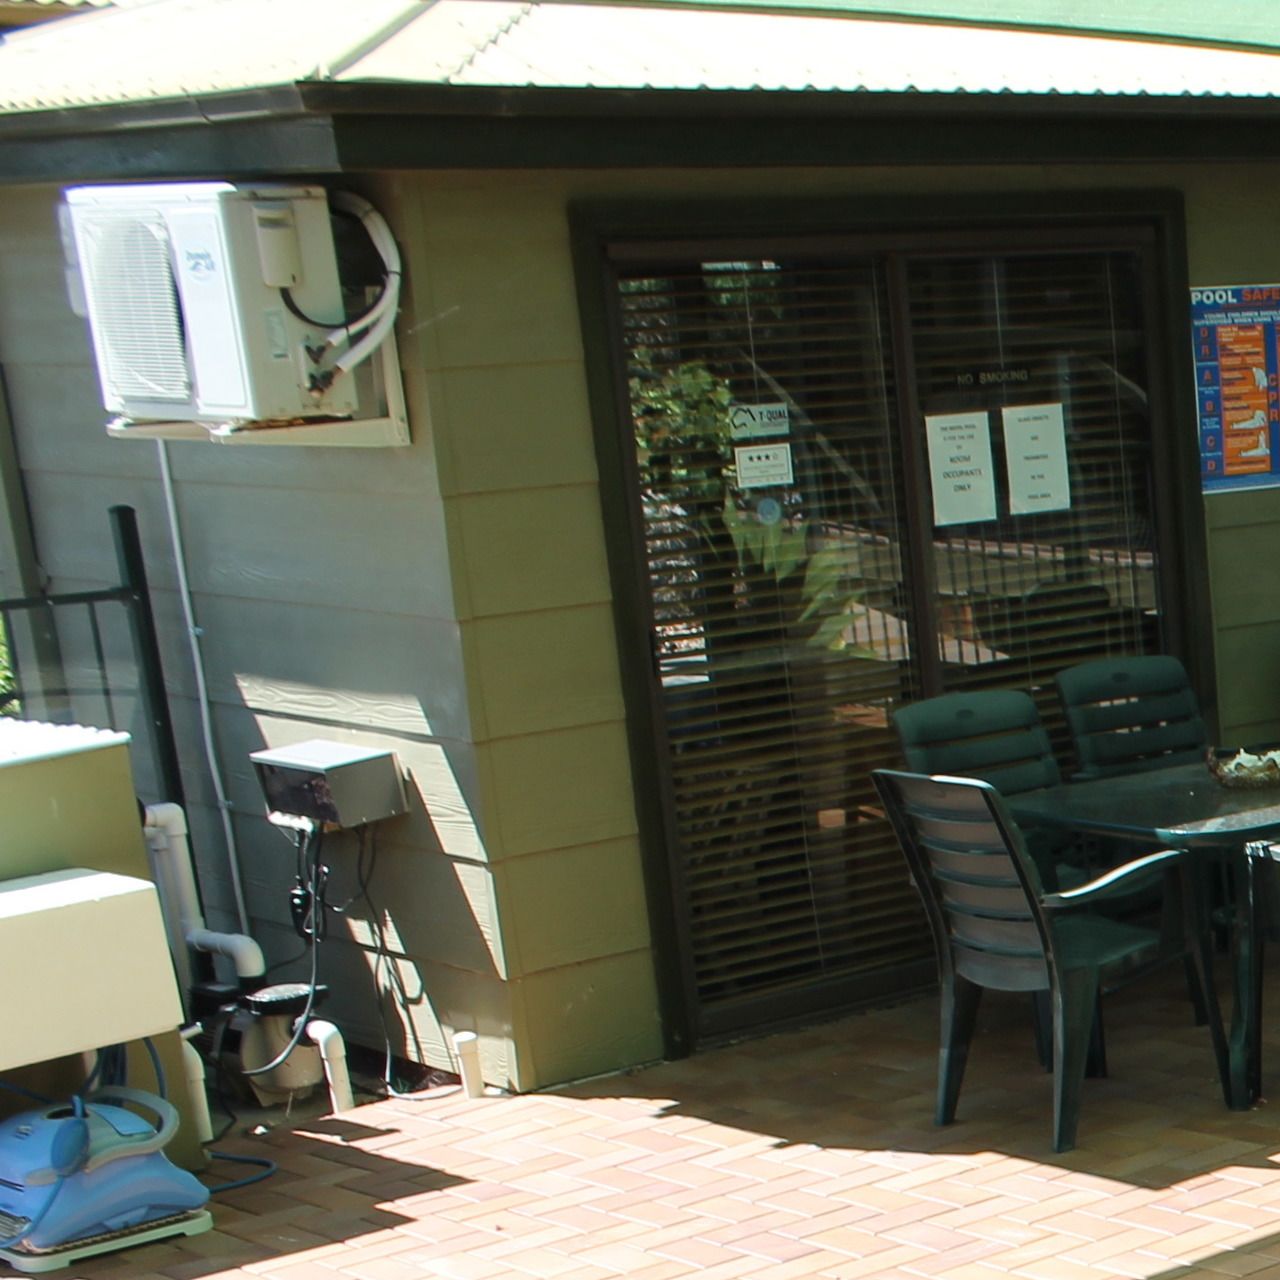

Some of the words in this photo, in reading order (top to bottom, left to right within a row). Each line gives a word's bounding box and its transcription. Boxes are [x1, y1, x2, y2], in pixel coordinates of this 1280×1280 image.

[1191, 290, 1237, 305] POOL
[957, 374, 974, 385] NO
[979, 371, 1028, 384] SMOKING
[943, 469, 983, 480] OCCUPANTS
